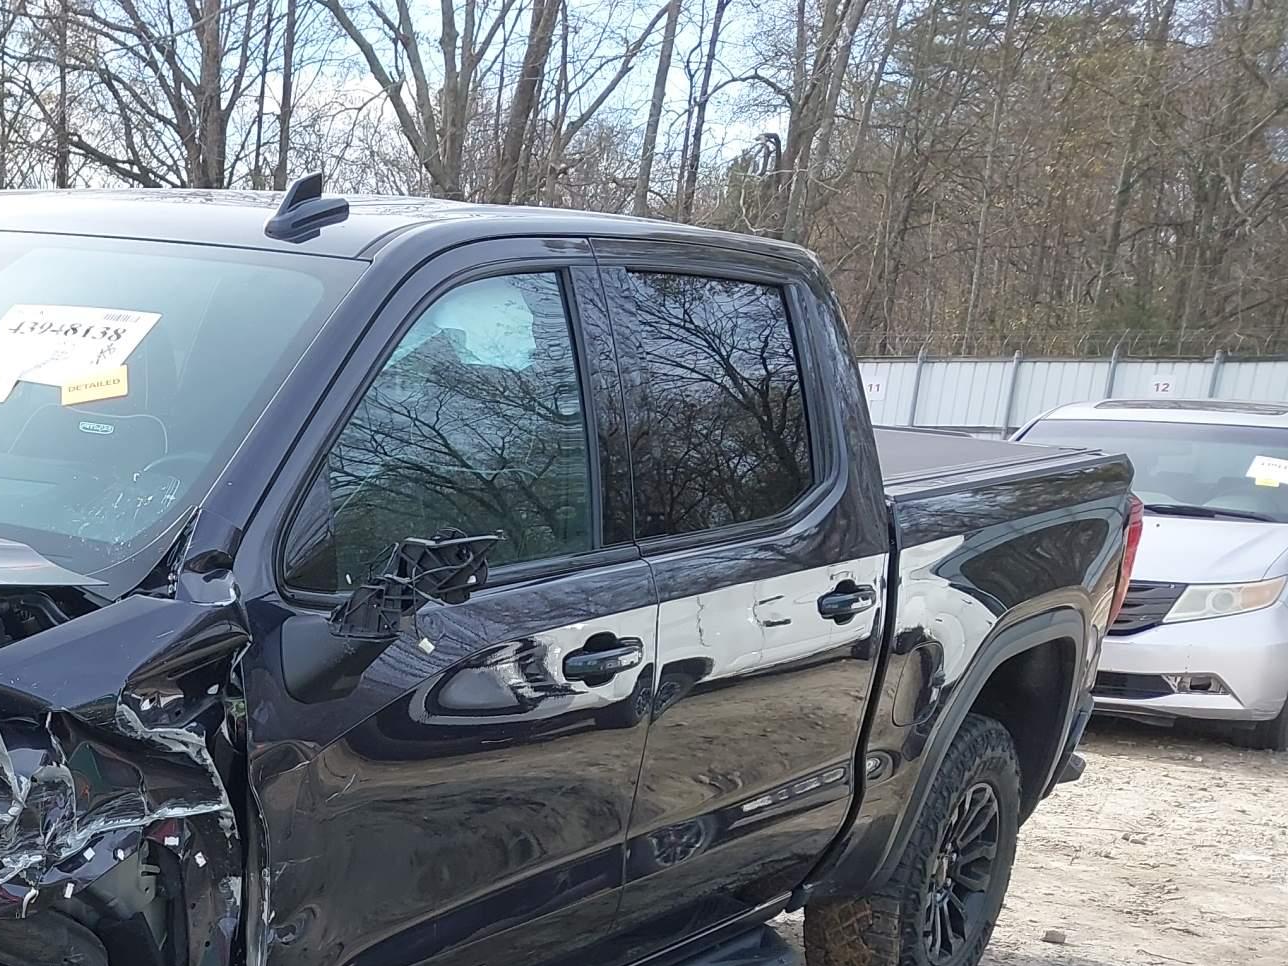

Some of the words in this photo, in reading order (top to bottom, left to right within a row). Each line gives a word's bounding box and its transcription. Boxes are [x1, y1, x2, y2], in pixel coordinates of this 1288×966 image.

[68, 377, 121, 393] DETAILED
[867, 383, 881, 393] 11
[1154, 382, 1170, 393] 12
